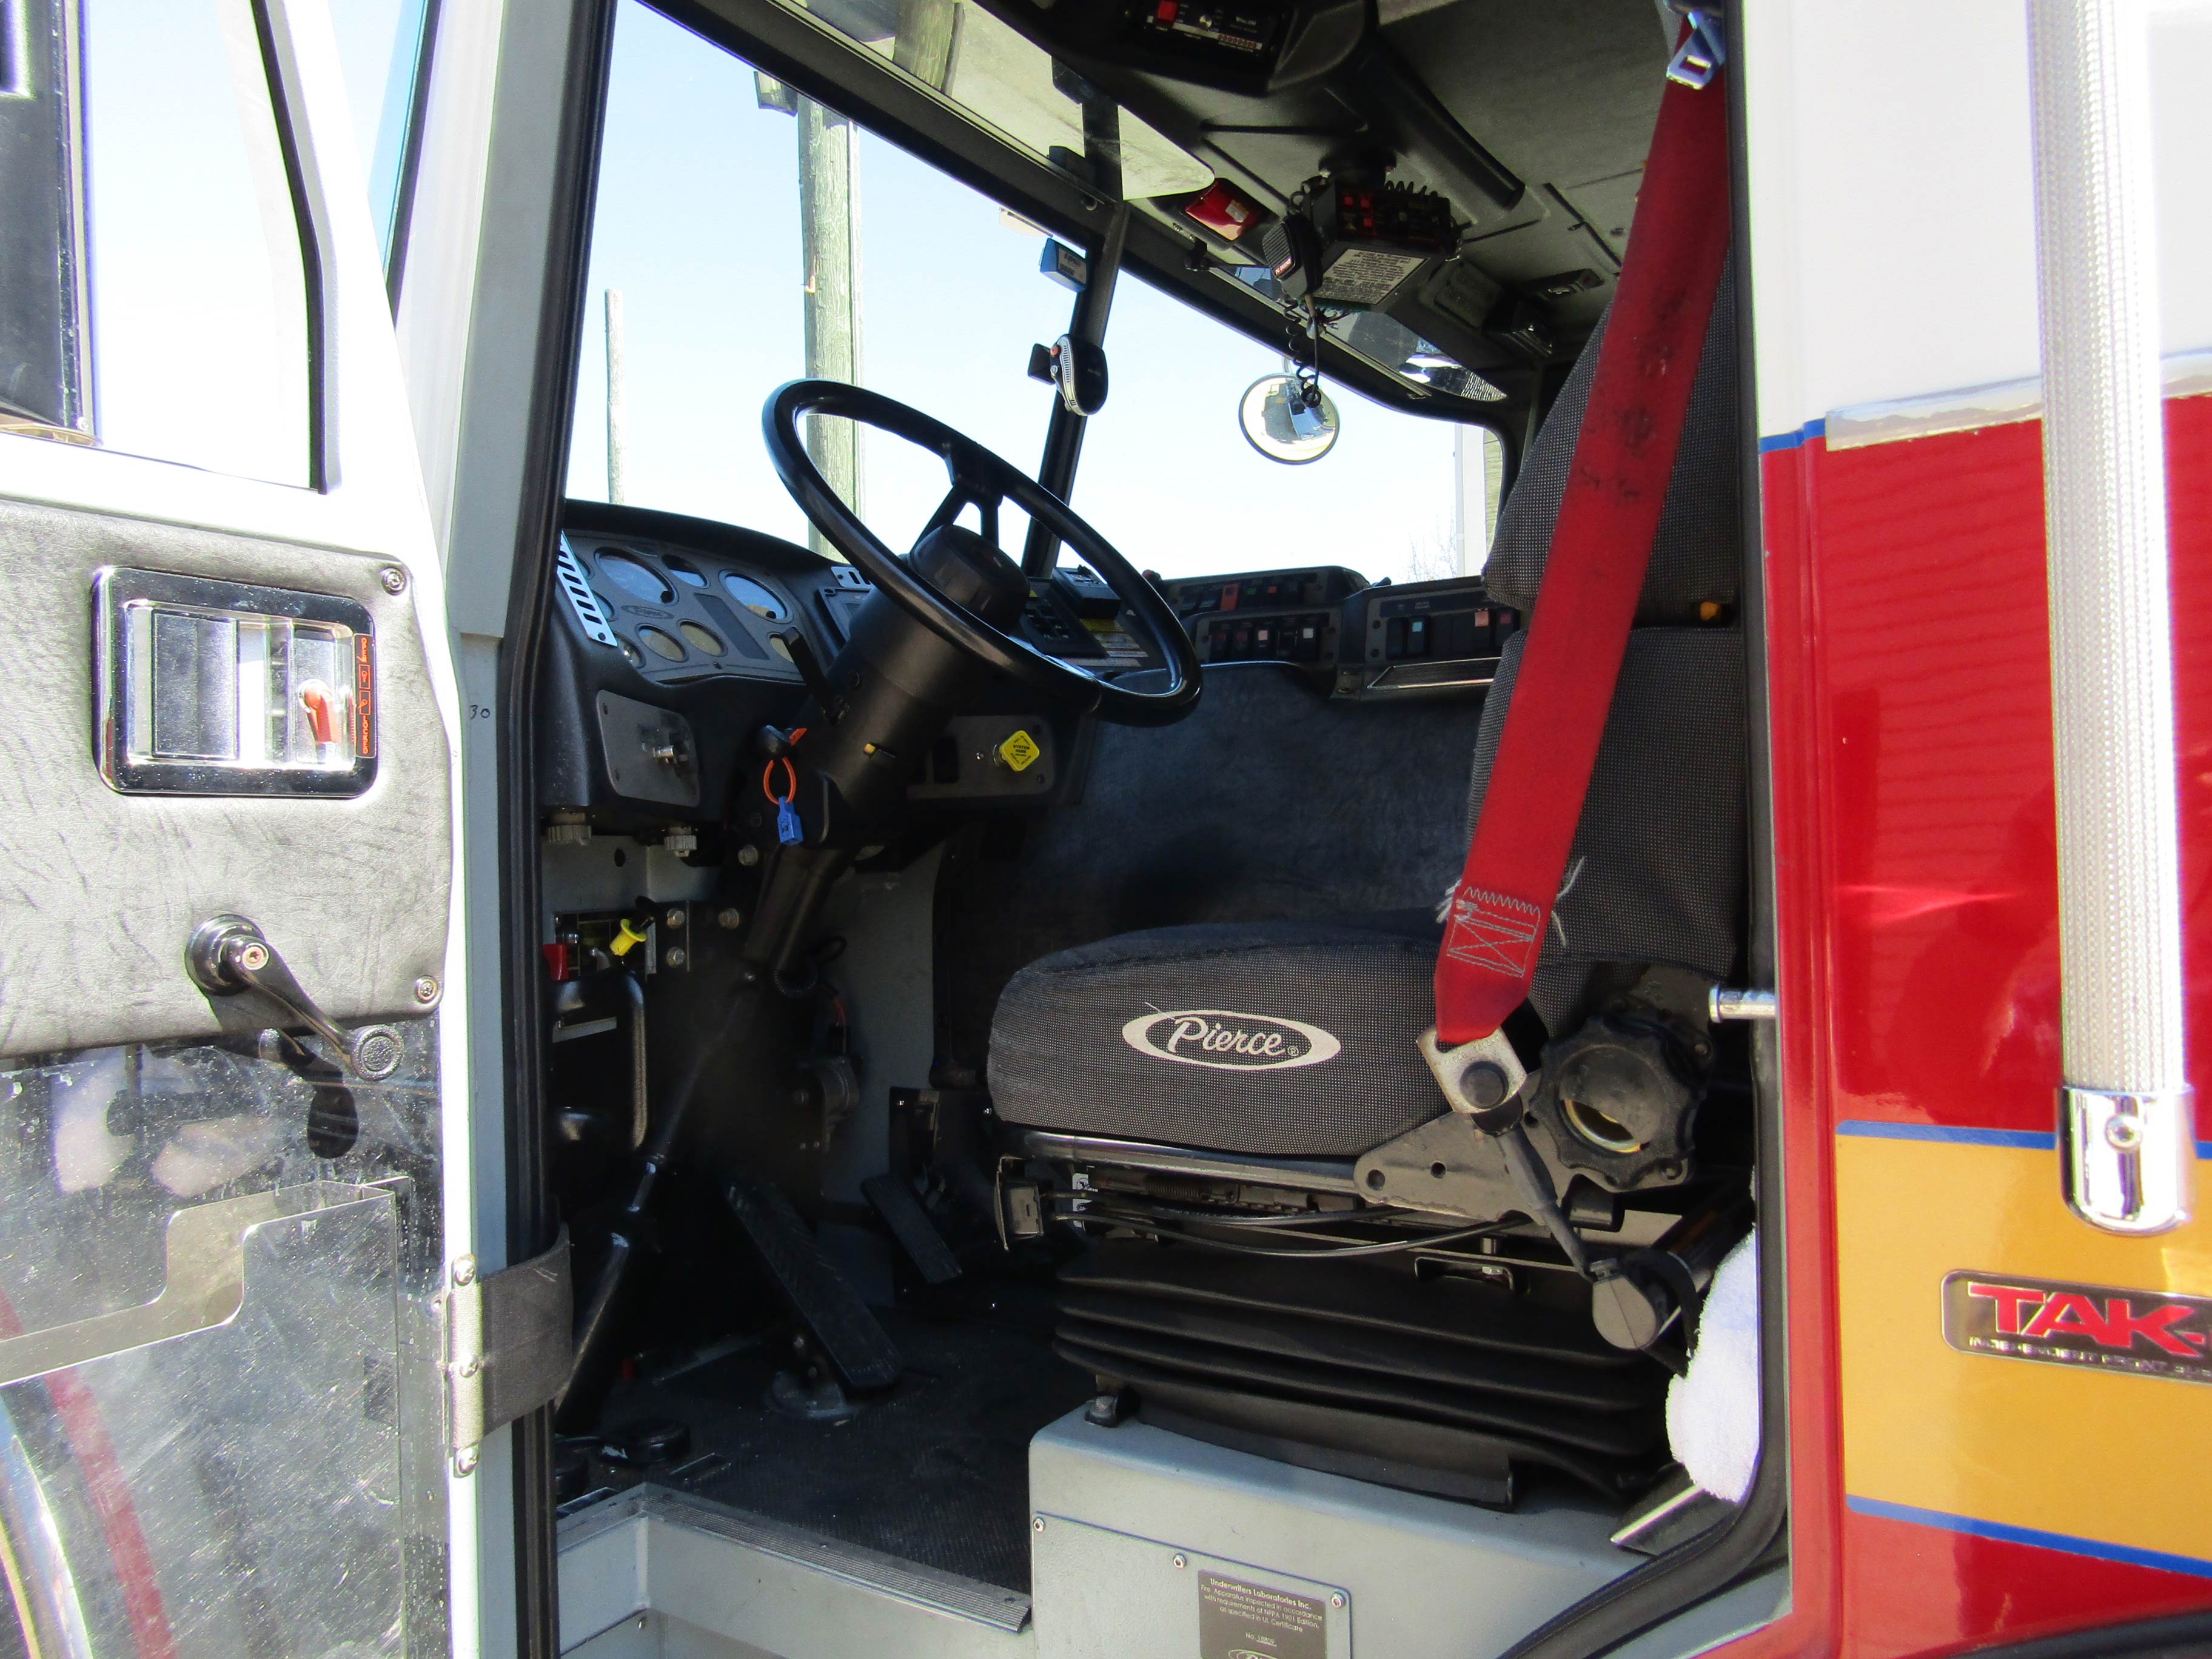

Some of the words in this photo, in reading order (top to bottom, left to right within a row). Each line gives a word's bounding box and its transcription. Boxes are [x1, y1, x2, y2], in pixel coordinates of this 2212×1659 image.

[470, 705, 490, 720] 30
[1167, 1016, 1288, 1056] Pierce
[1968, 1281, 2212, 1358] TAK-
[2101, 1354, 2167, 1372] FRONT
[1210, 1578, 1252, 1594] Underwriters
[1253, 1589, 1296, 1606] Laboratories
[1298, 1600, 1312, 1610] Inc.
[1214, 1589, 1244, 1601] Apparatus
[1245, 1596, 1275, 1609] inspected
[1284, 1607, 1322, 1621] accordance
[1217, 1598, 1255, 1612] requirements
[1264, 1609, 1281, 1618] NFPA
[1228, 1607, 1255, 1620] specified
[1271, 1618, 1303, 1632] Certificate
